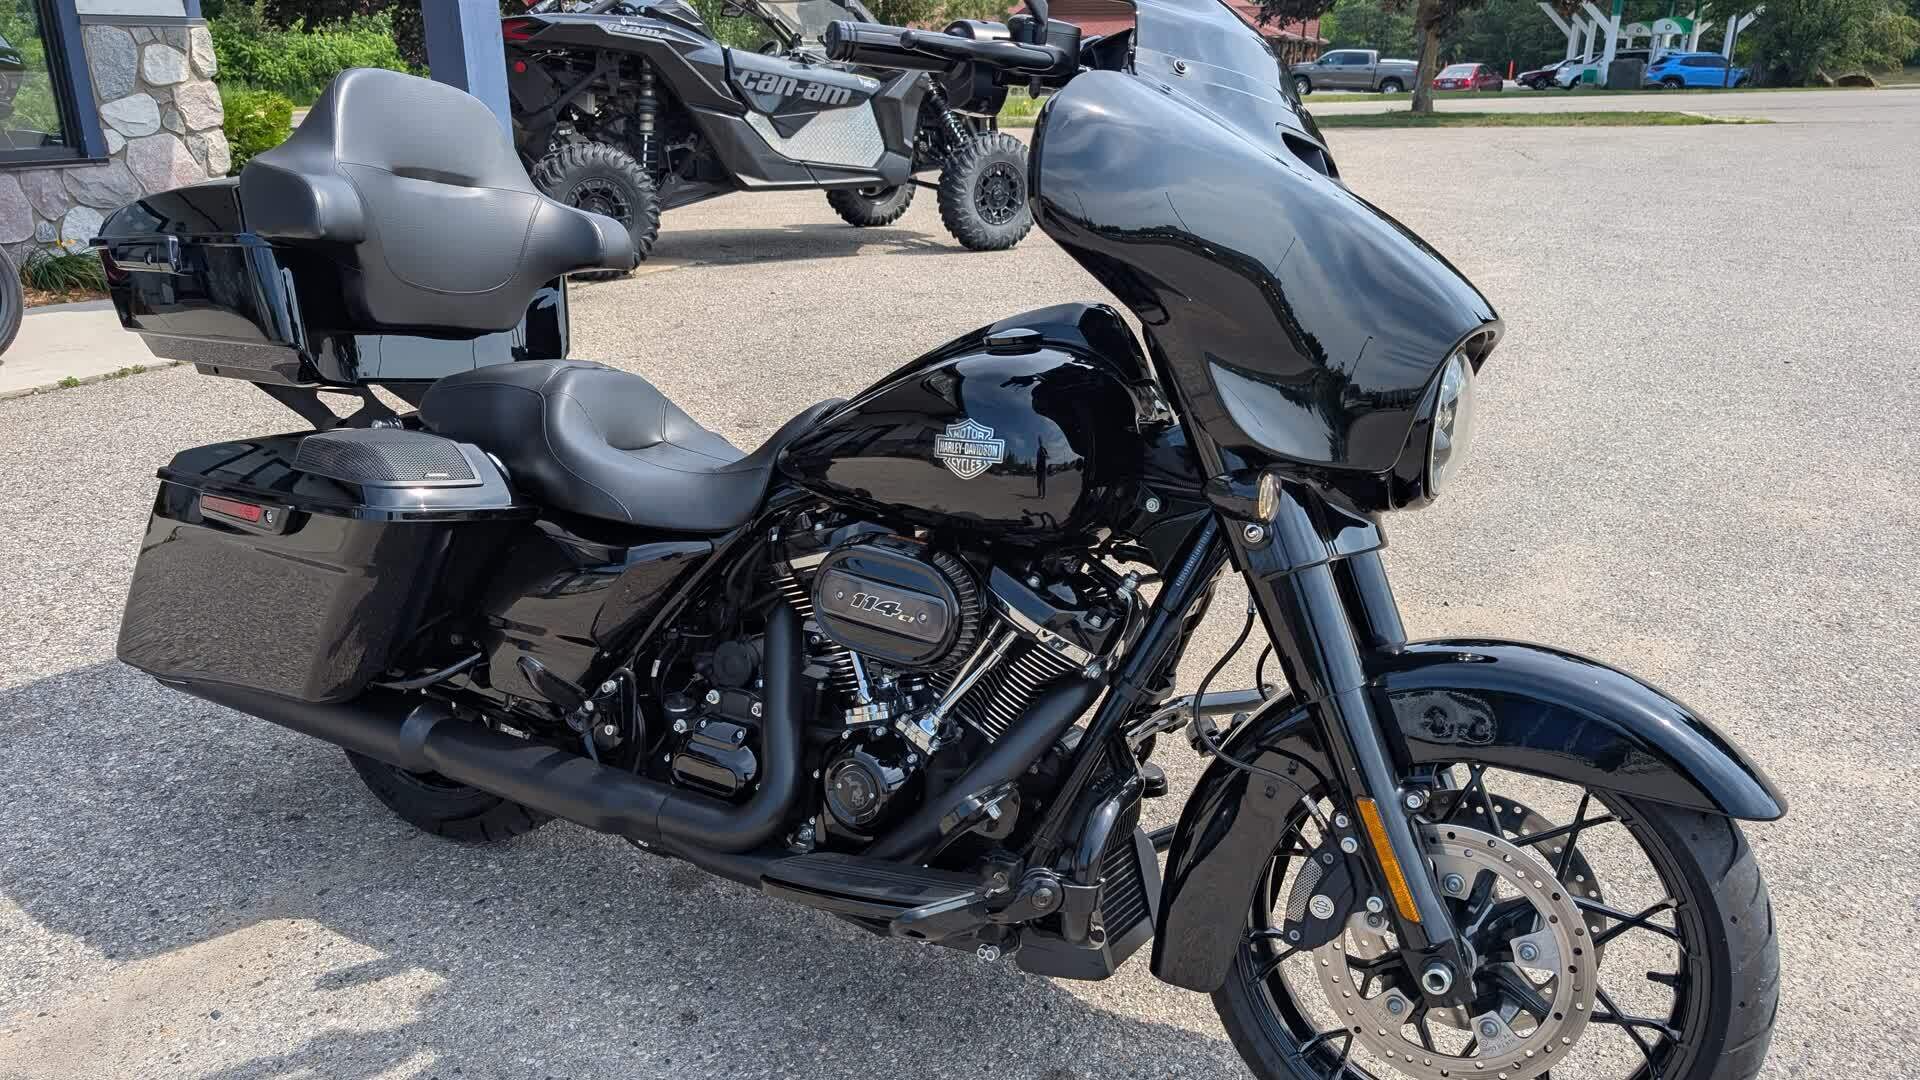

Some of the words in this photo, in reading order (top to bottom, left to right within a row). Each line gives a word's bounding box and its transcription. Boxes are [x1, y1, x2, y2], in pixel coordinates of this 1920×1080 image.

[738, 69, 852, 105] can-am
[952, 425, 985, 441] MOTOR
[939, 440, 999, 457] HARLEY-DAVIDSON
[951, 457, 983, 474] CYCLES
[850, 592, 903, 617] 114
